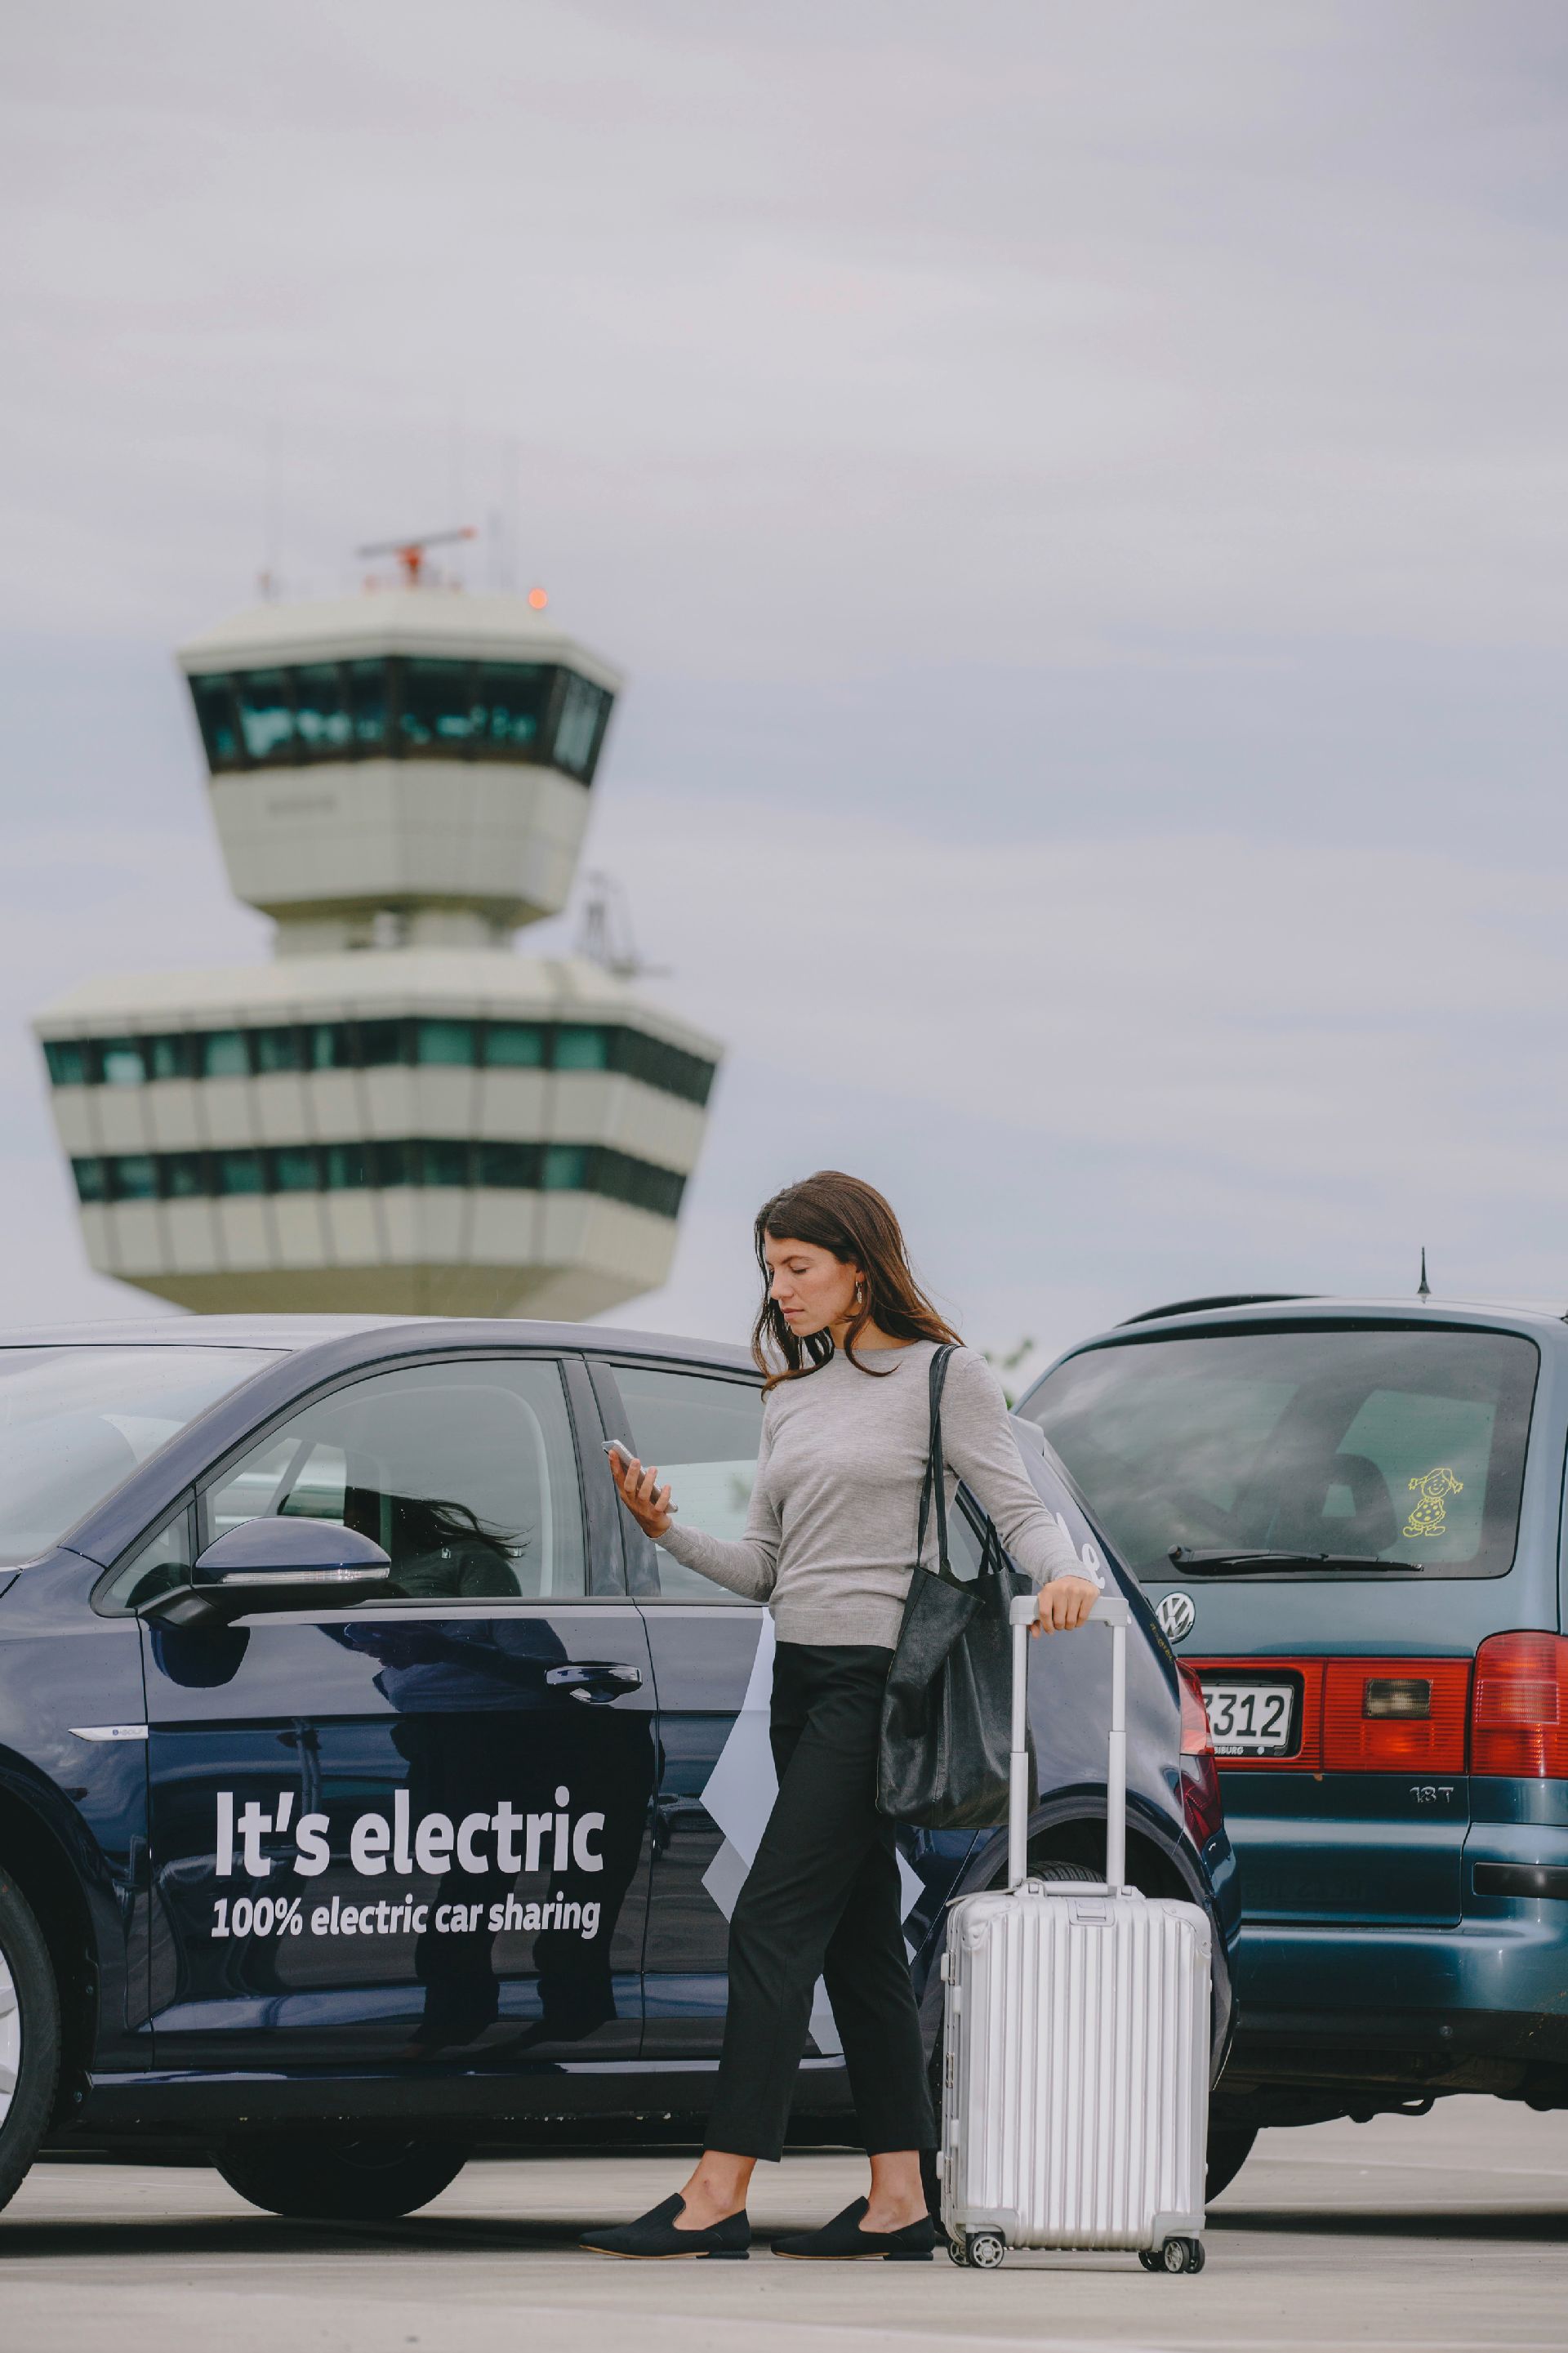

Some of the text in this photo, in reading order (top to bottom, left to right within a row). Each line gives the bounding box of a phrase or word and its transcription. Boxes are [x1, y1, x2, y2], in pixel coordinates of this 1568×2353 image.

[216, 1785, 605, 1877] It's electric
[212, 1891, 600, 1939] 100% electric car sharing
